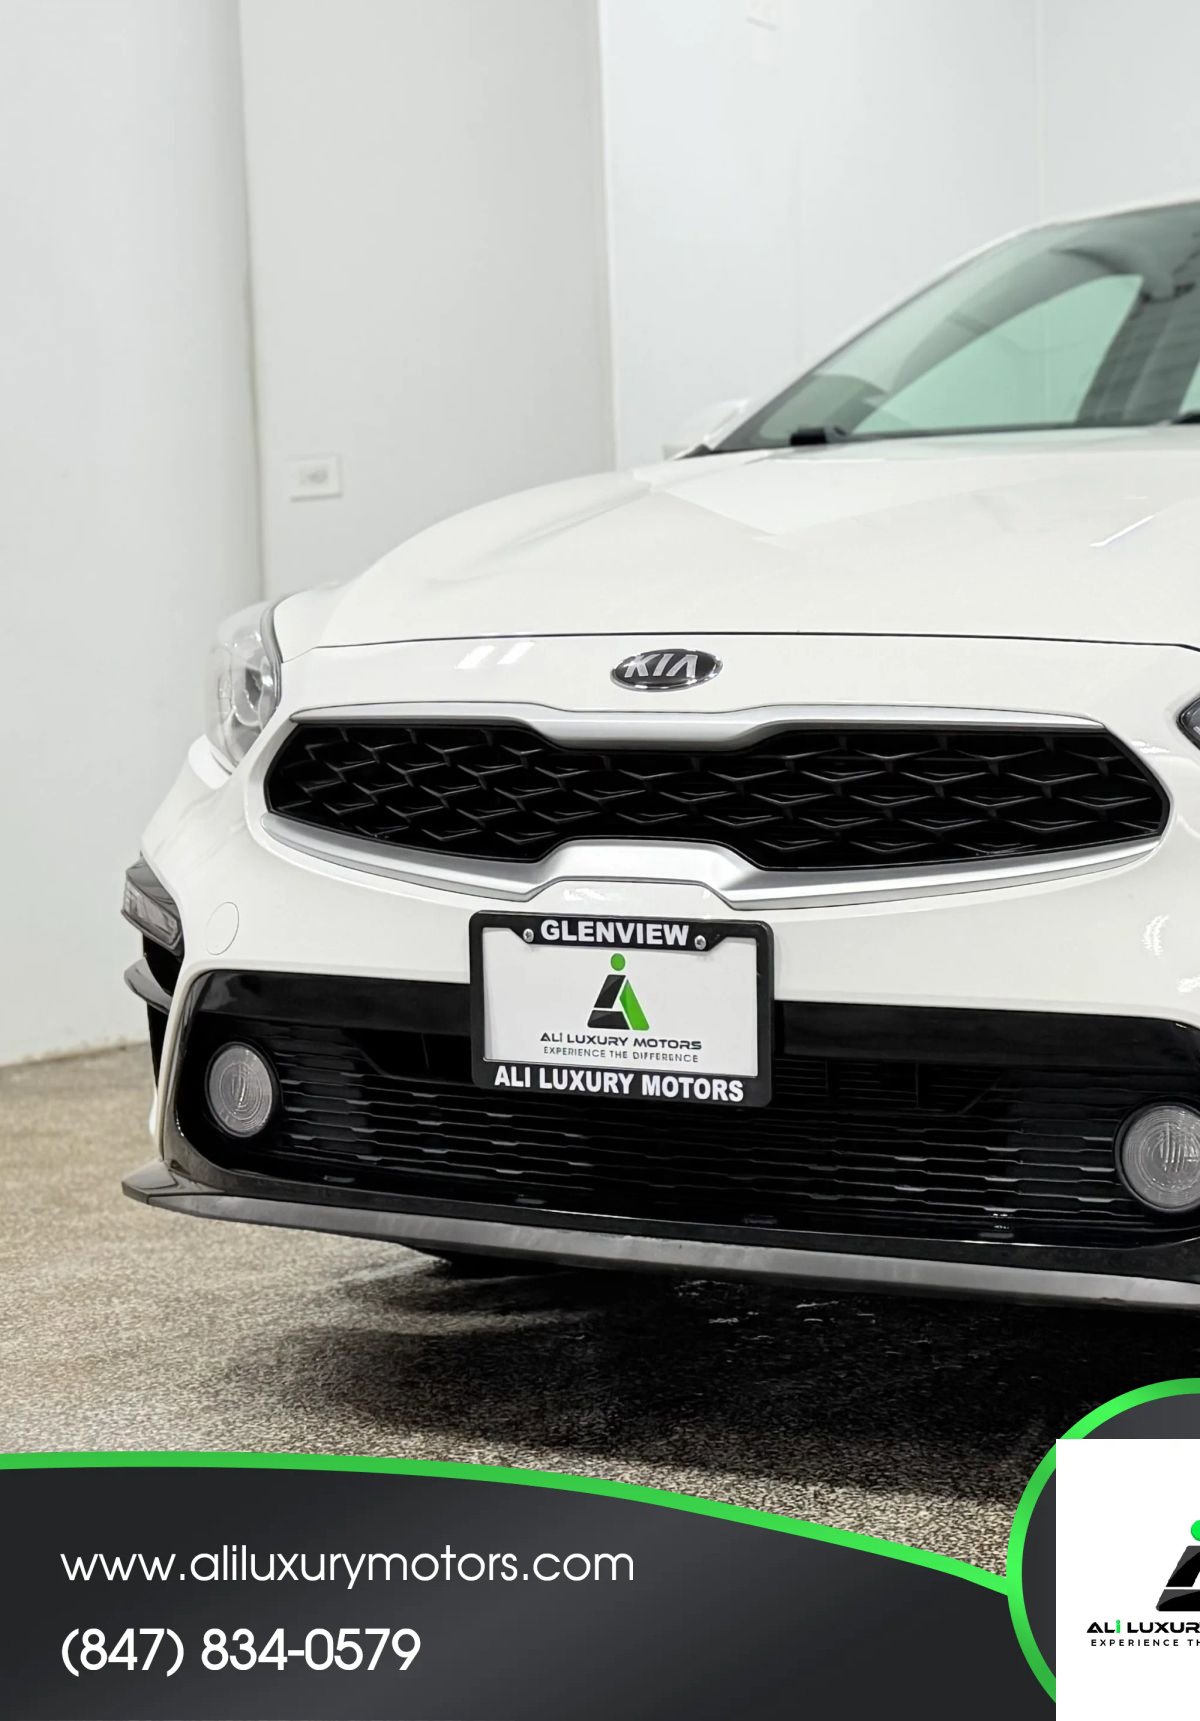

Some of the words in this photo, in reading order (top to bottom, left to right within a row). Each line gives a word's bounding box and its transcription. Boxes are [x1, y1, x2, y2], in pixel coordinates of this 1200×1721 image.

[623, 653, 699, 679] KIA
[540, 919, 690, 946] GLENVIEW
[544, 1046, 606, 1058] EXPERIENCE
[610, 1050, 628, 1059] THE
[632, 1052, 699, 1063] DIFFERENCE
[566, 1034, 628, 1047] LUXURY
[633, 1038, 702, 1050] MOTORS
[494, 1065, 531, 1088] ALI
[539, 1067, 635, 1095] LUXURY
[641, 1074, 744, 1102] MOTORS
